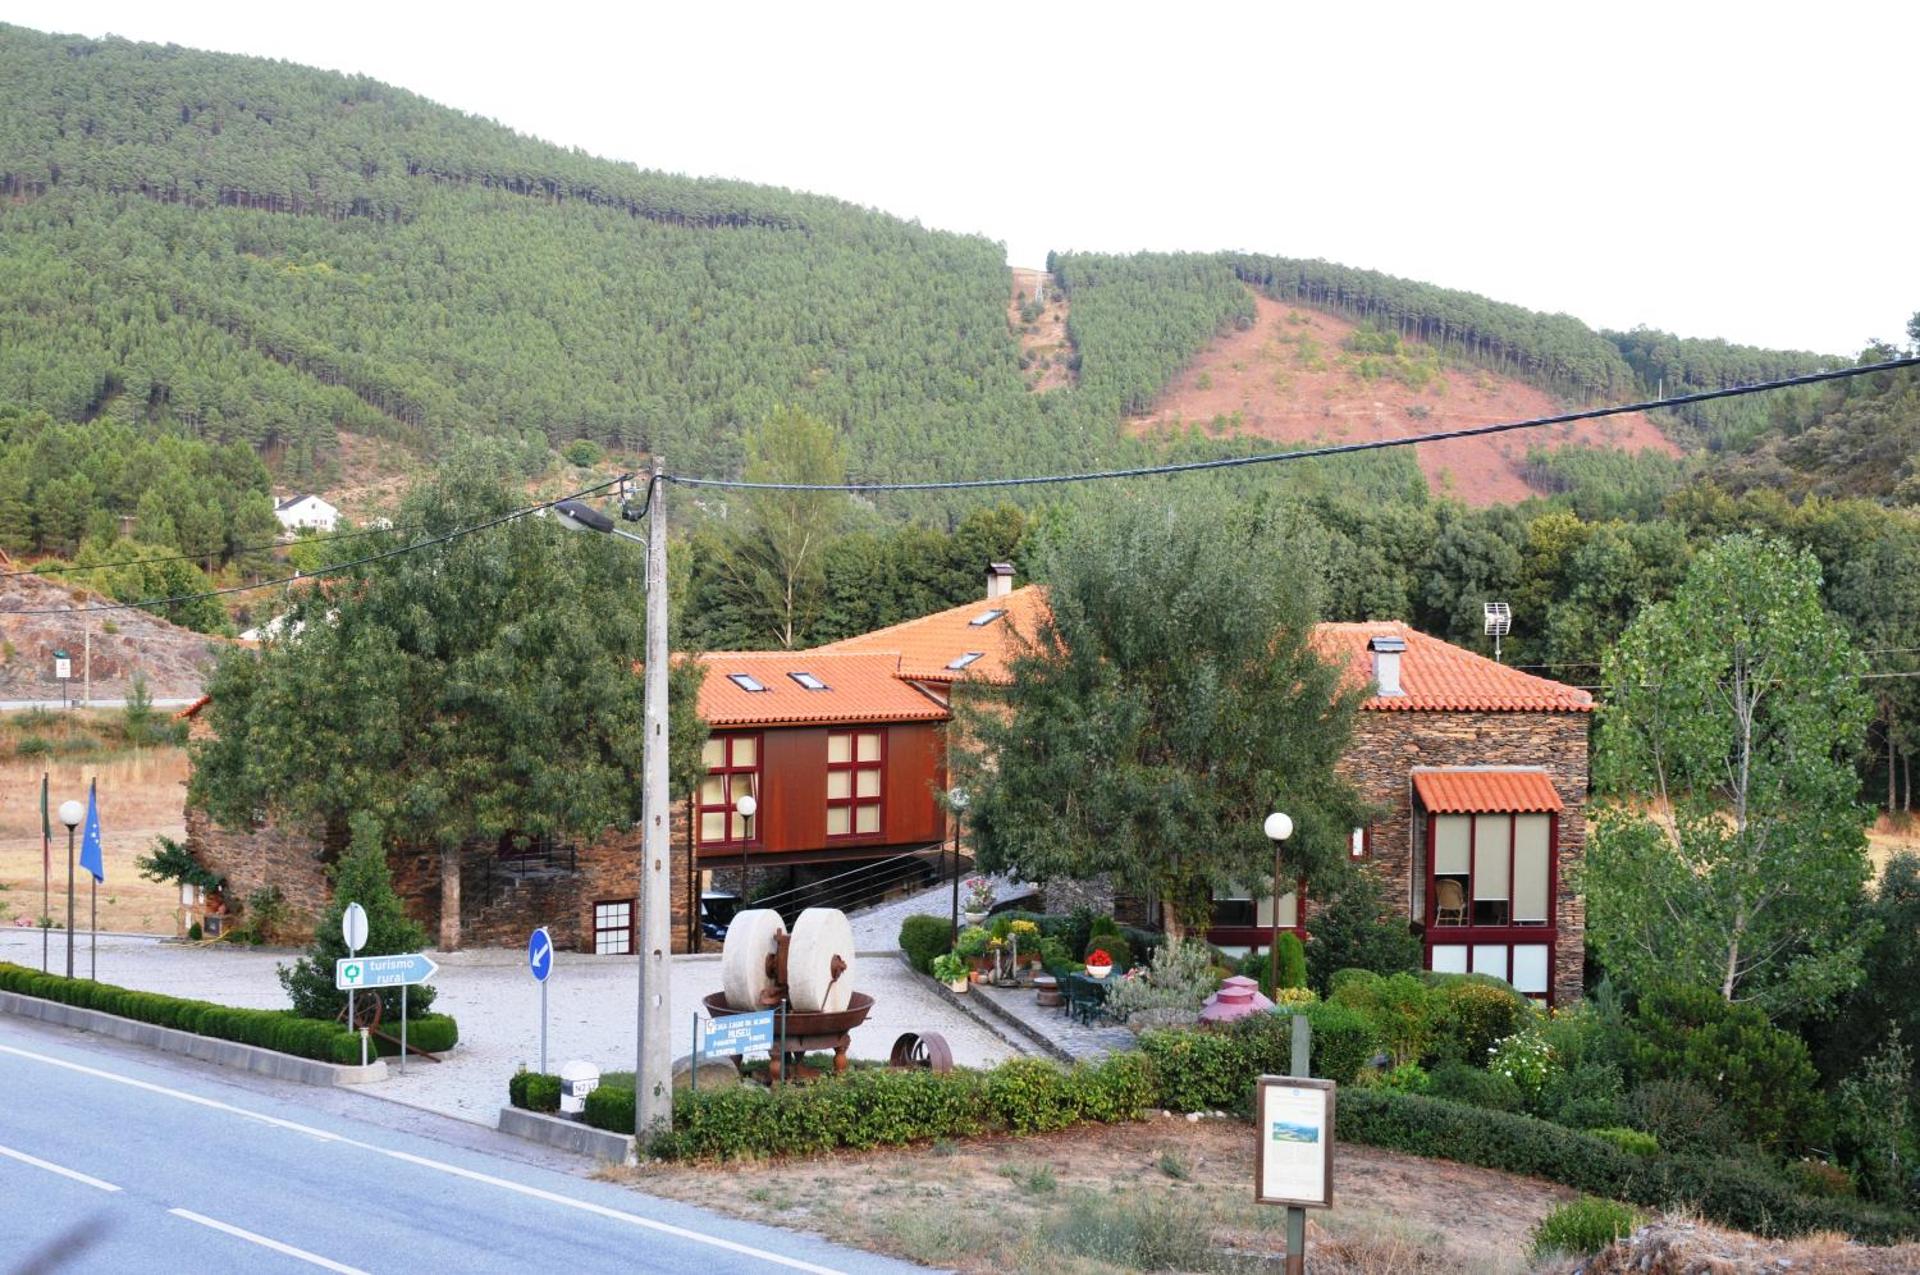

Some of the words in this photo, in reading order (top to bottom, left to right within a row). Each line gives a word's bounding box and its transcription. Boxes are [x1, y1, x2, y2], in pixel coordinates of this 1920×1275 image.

[370, 959, 414, 971] turismo
[377, 971, 405, 984] rural
[728, 1027, 751, 1039] MUSEU
